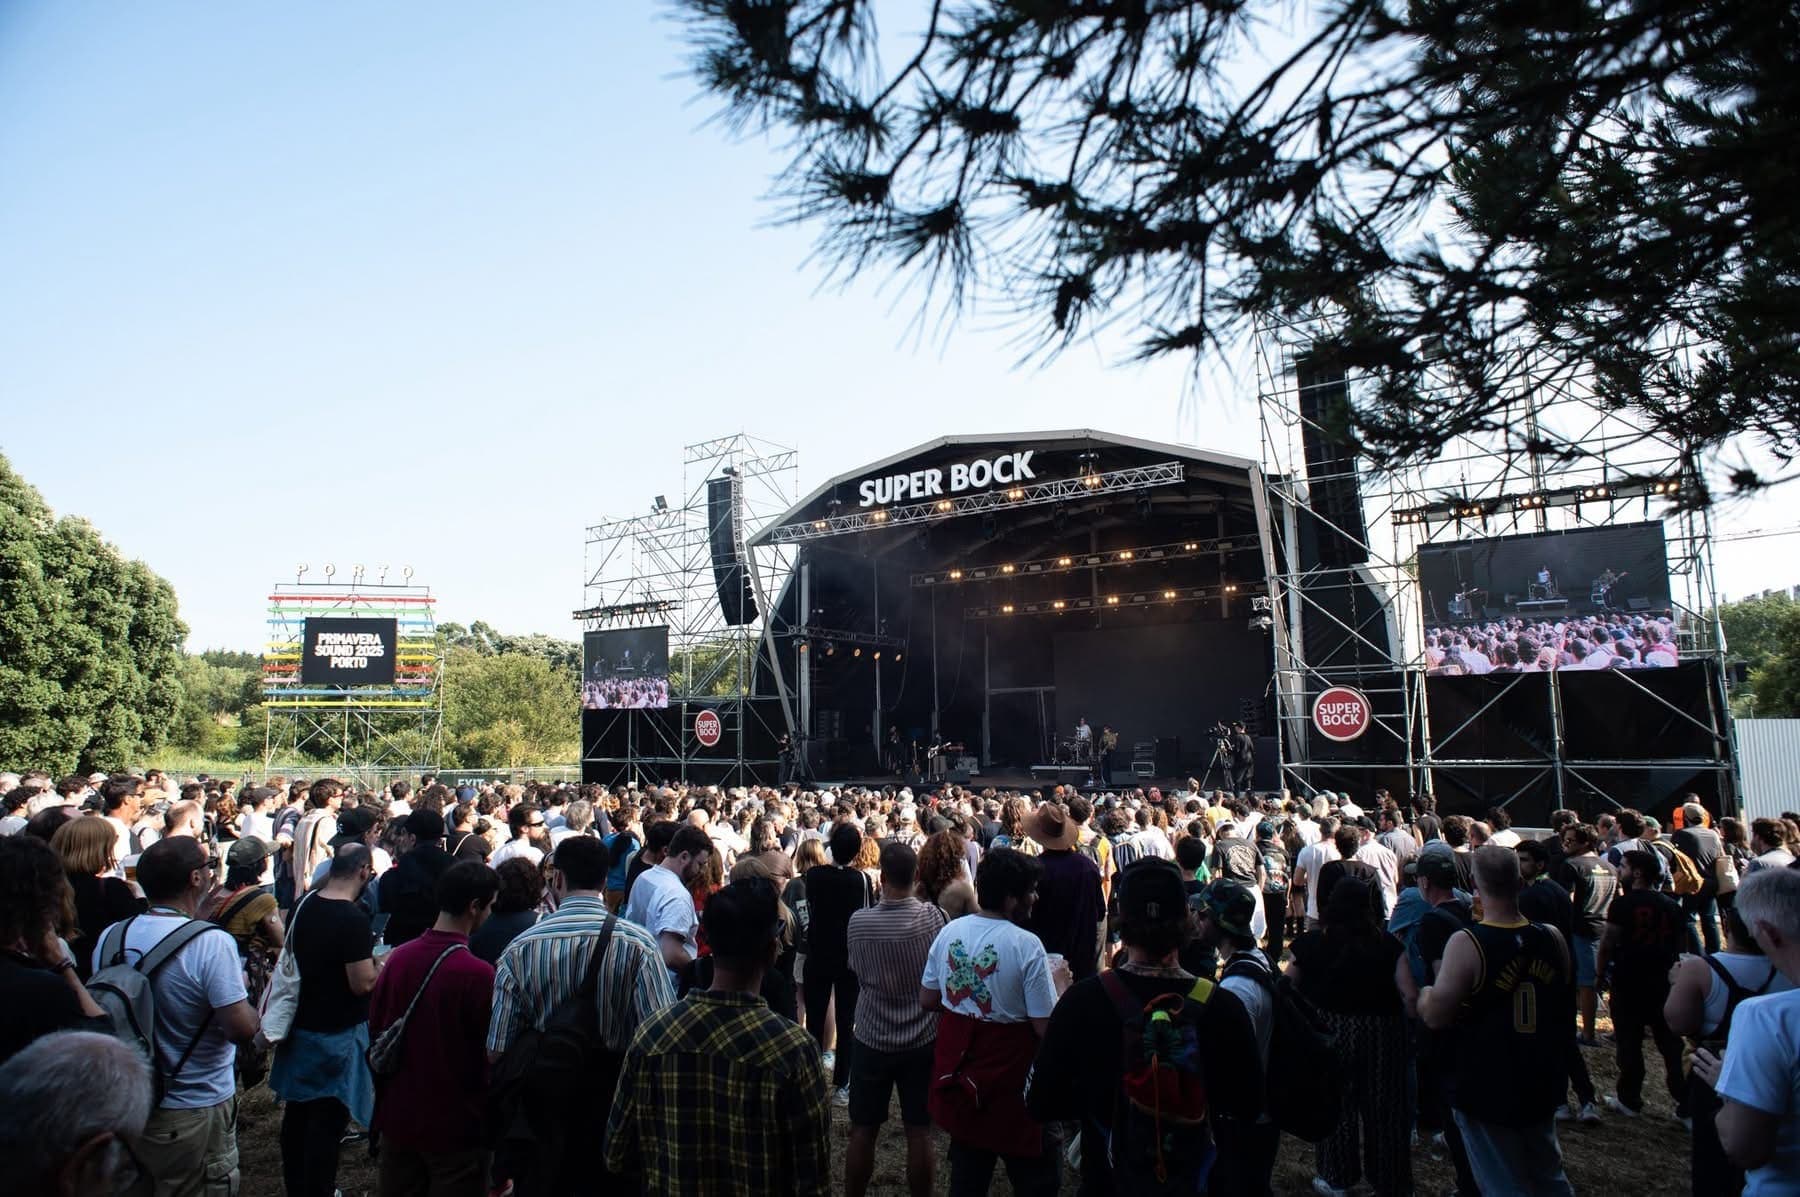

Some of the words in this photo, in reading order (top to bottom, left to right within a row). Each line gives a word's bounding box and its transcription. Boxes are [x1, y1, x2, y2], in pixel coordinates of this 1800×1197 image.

[859, 468, 943, 507] SUPER
[950, 450, 1036, 491] BOCK
[296, 562, 414, 578] PORTO
[317, 633, 382, 645] PRIMAVERA
[314, 645, 354, 656] SOUND
[354, 645, 385, 657] 2025
[330, 657, 368, 668] PORTO
[1319, 702, 1361, 714] SUPER
[698, 720, 718, 729] SUPER
[1322, 713, 1361, 726] BOCK
[699, 728, 718, 736] BOCK
[1513, 981, 1537, 1033] 0
